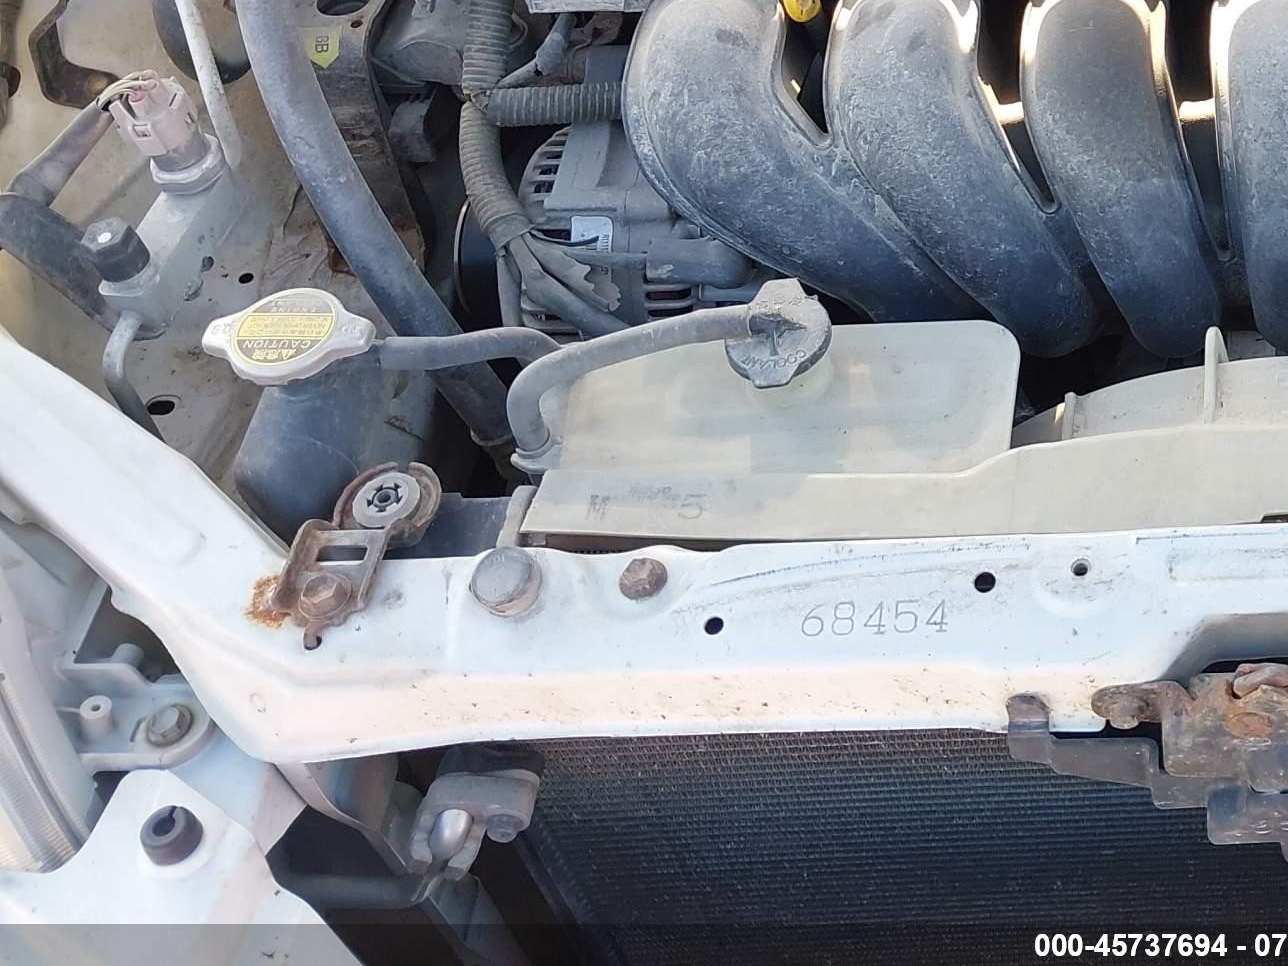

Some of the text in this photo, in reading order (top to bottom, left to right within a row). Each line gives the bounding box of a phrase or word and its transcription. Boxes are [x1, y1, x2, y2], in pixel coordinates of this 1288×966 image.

[243, 339, 312, 349] CAUTION
[740, 349, 807, 369] COOLANT
[801, 599, 949, 637] 68454
